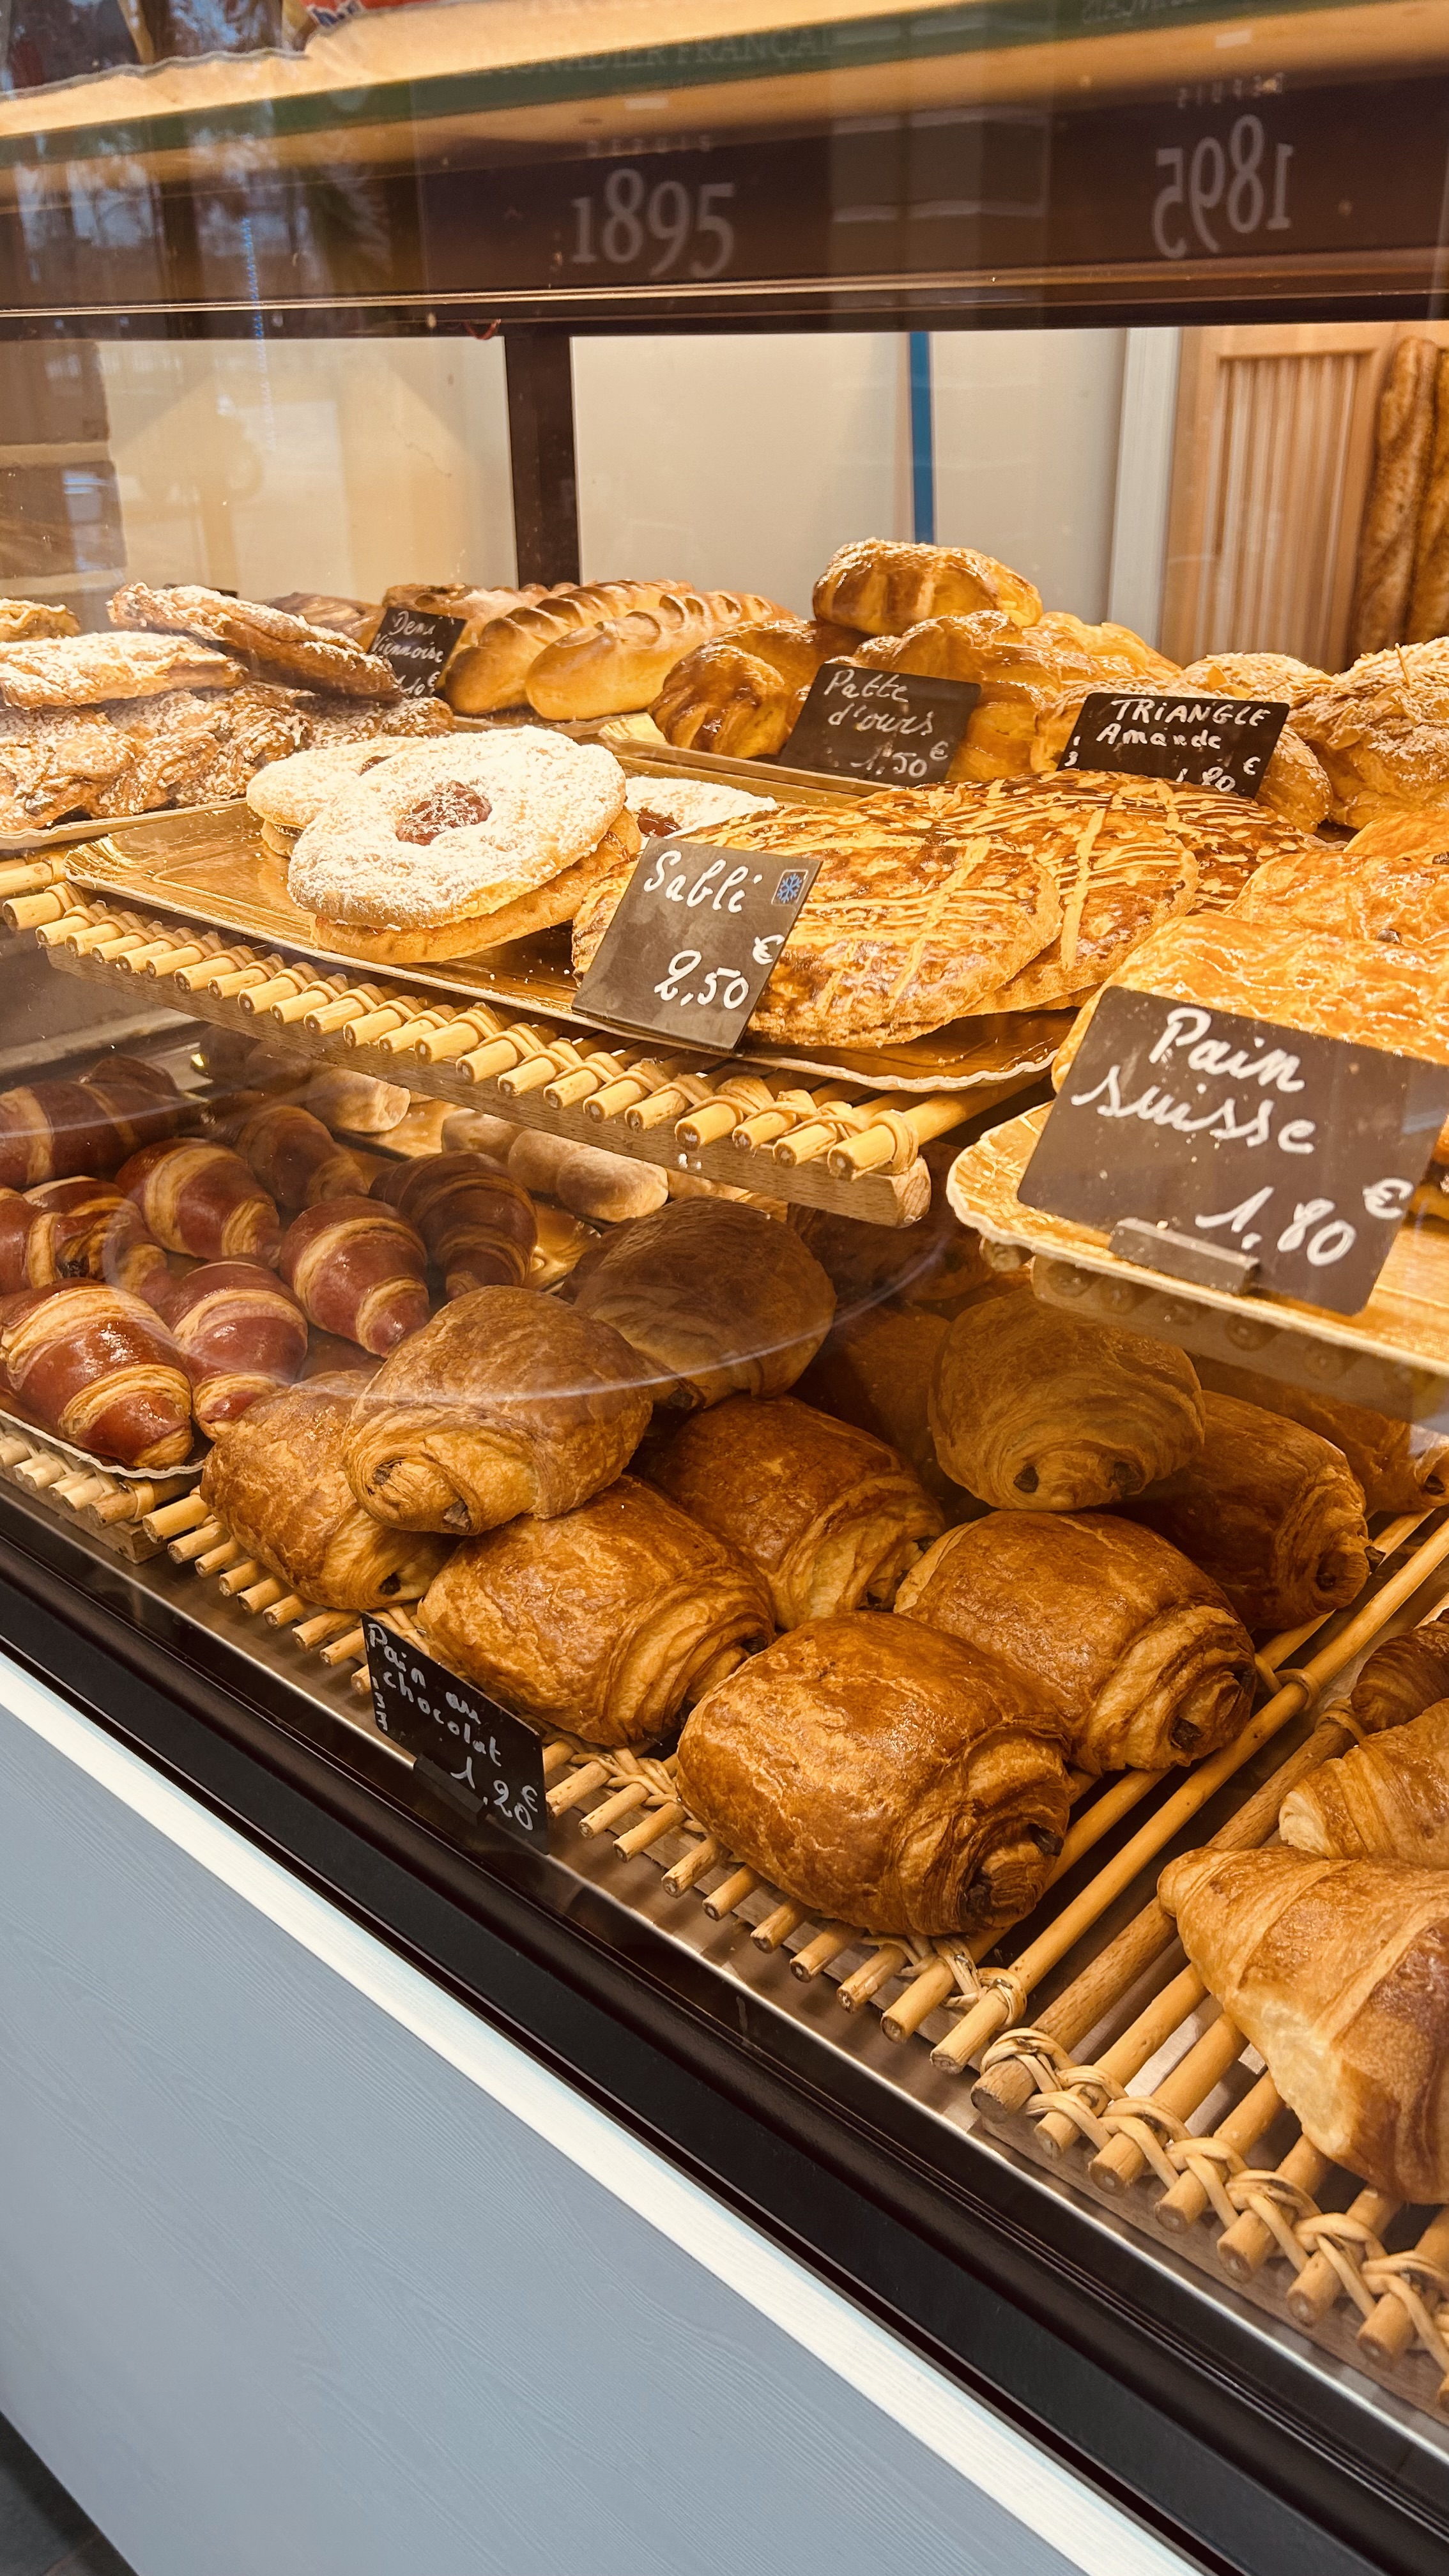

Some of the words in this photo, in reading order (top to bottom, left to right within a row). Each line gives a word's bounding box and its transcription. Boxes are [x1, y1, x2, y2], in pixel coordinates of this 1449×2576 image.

[571, 167, 735, 278] 1895
[824, 669, 909, 703] Patte
[828, 703, 935, 735] d'ours
[1096, 723, 1223, 749] Amande
[1148, 1006, 1307, 1093] Pain
[368, 1623, 427, 1689] Pain
[445, 1692, 481, 1724] au
[383, 1671, 502, 1767] chocolat
